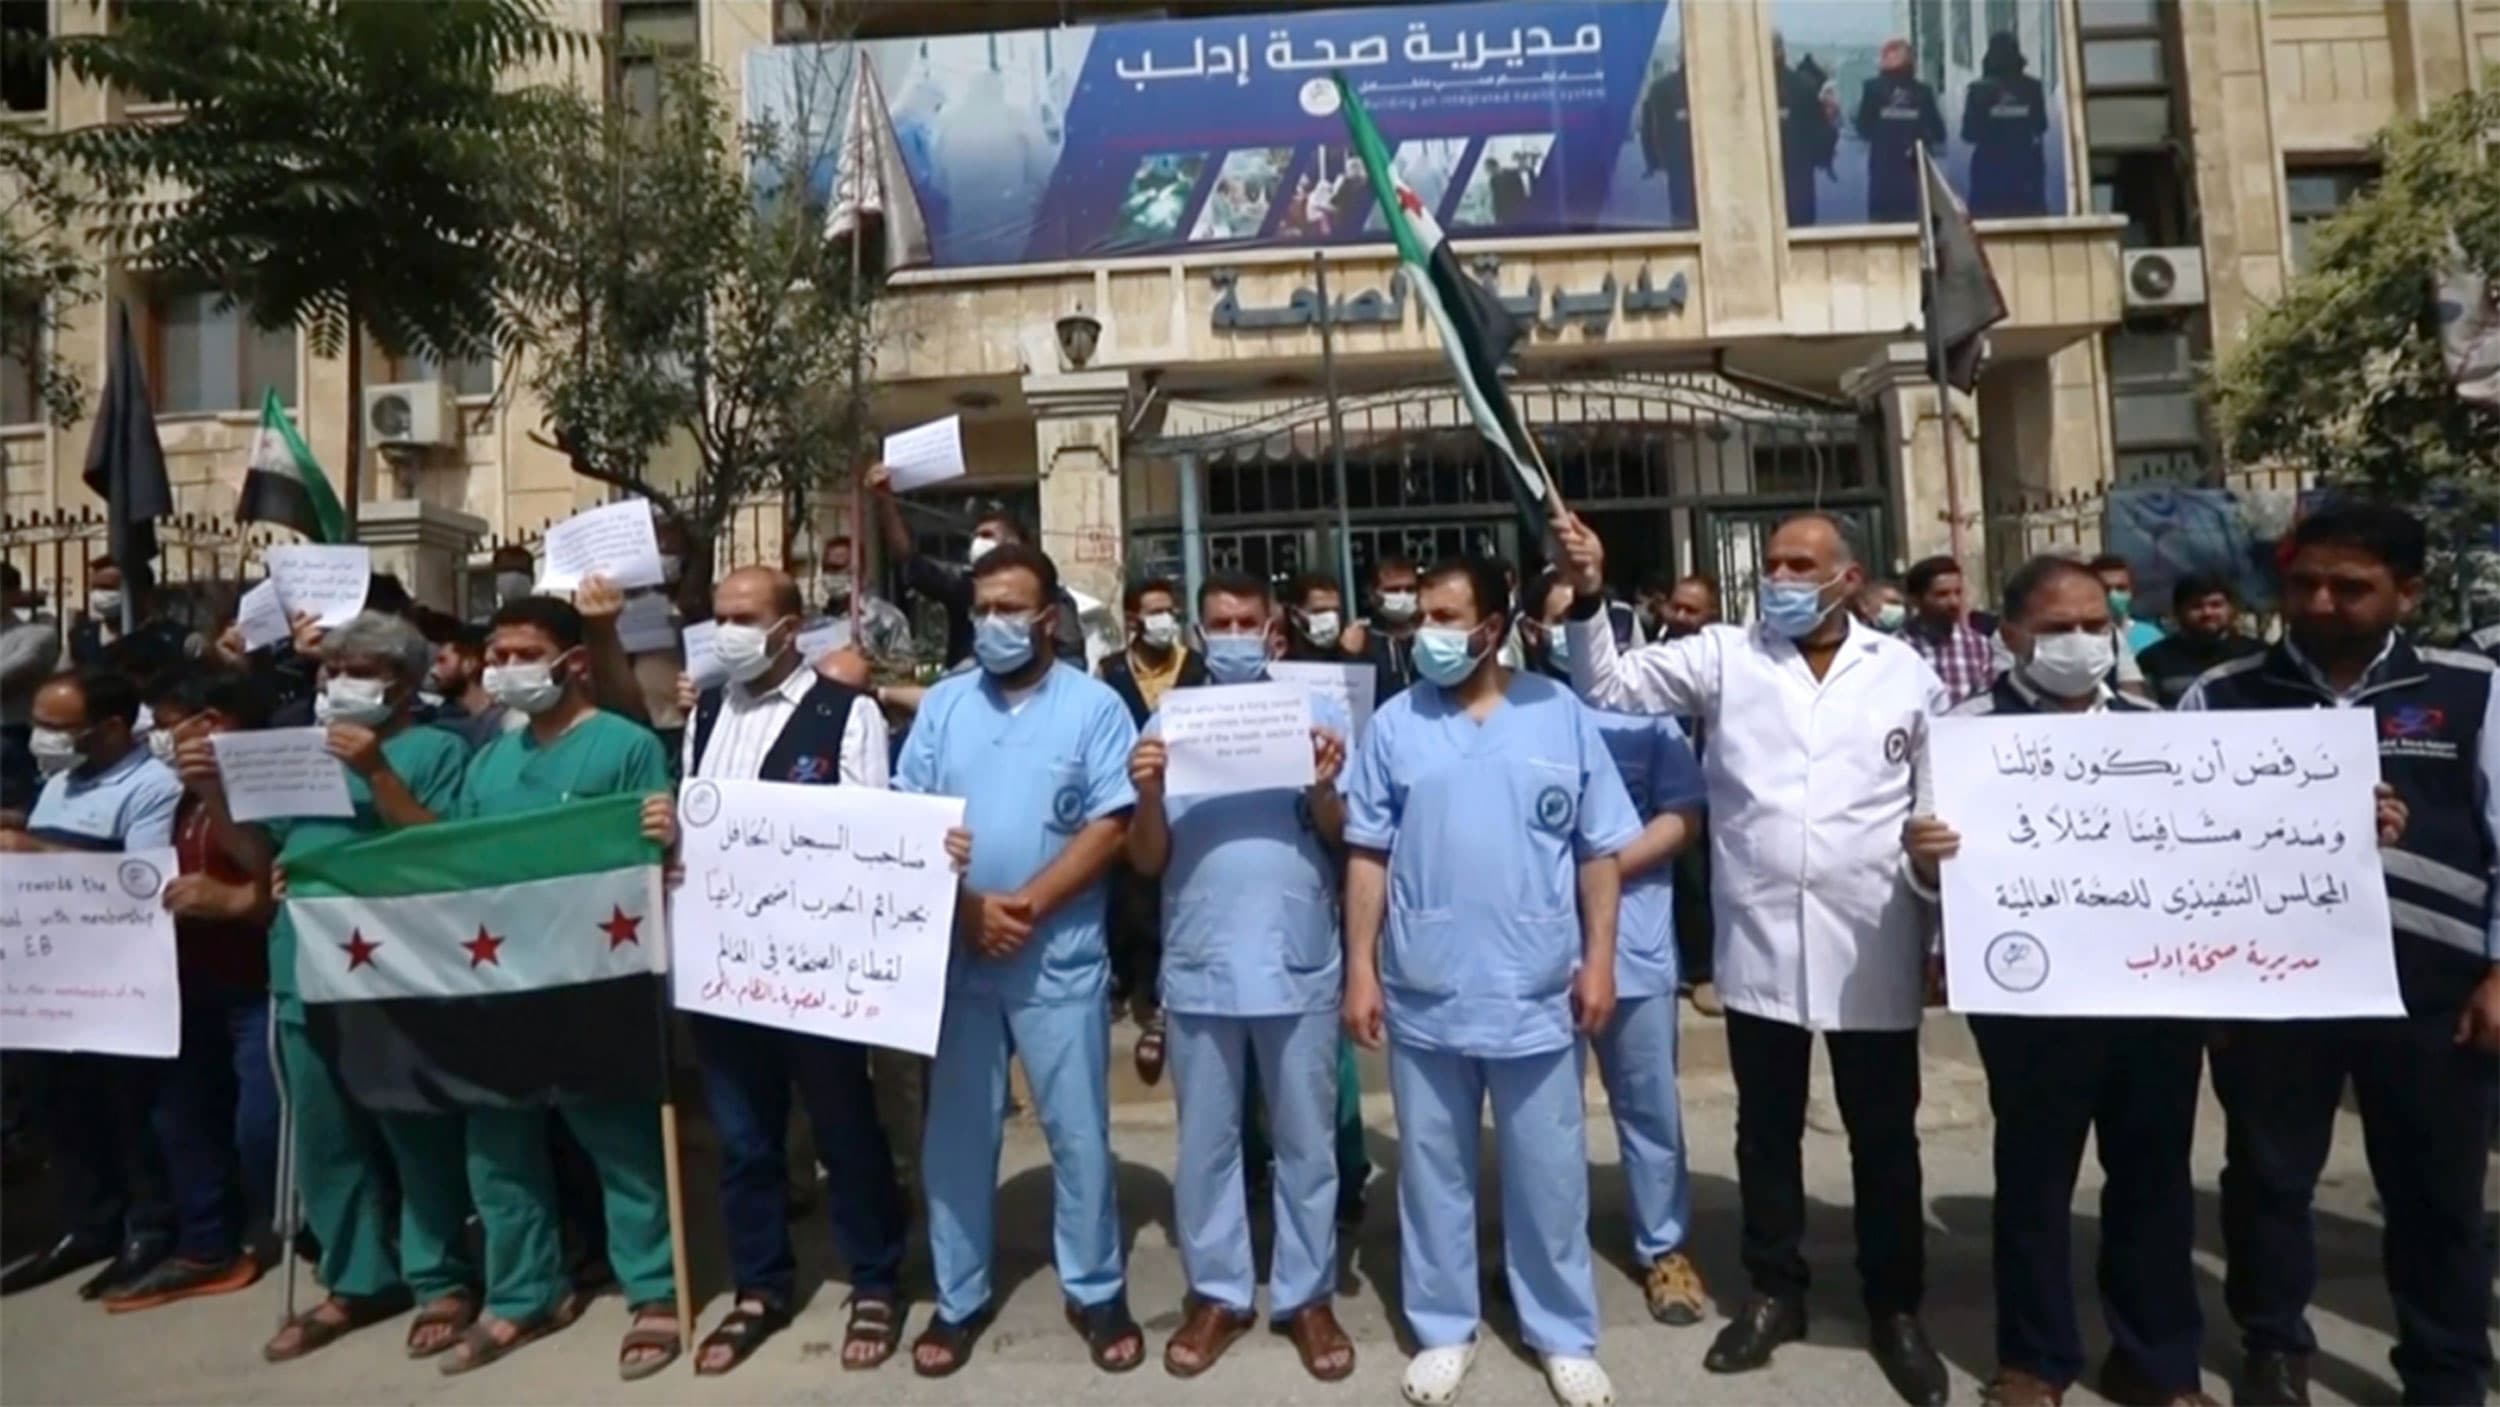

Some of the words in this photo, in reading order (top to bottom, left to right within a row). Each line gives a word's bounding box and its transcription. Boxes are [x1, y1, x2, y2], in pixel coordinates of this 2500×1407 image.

[1115, 33, 1250, 91] إدلب
[1265, 29, 1388, 69] صحة
[1403, 22, 1602, 70] مديرية
[2064, 742, 2184, 787] يكون
[2192, 738, 2227, 785] أن
[2233, 738, 2340, 788] نرفض
[719, 817, 775, 851] الحافل
[781, 823, 850, 860] السجل
[853, 835, 926, 870] صاحب
[81, 874, 106, 893] the
[801, 885, 863, 920] الحرب
[1996, 875, 2069, 918] العالمية
[2074, 875, 2151, 908] للصحة
[2264, 871, 2349, 916] المجلس
[40, 908, 71, 926] with
[786, 942, 843, 973] الصحة
[845, 949, 902, 994] لقطاع
[2189, 943, 2238, 974] صحة
[2247, 940, 2320, 983] مديرية
